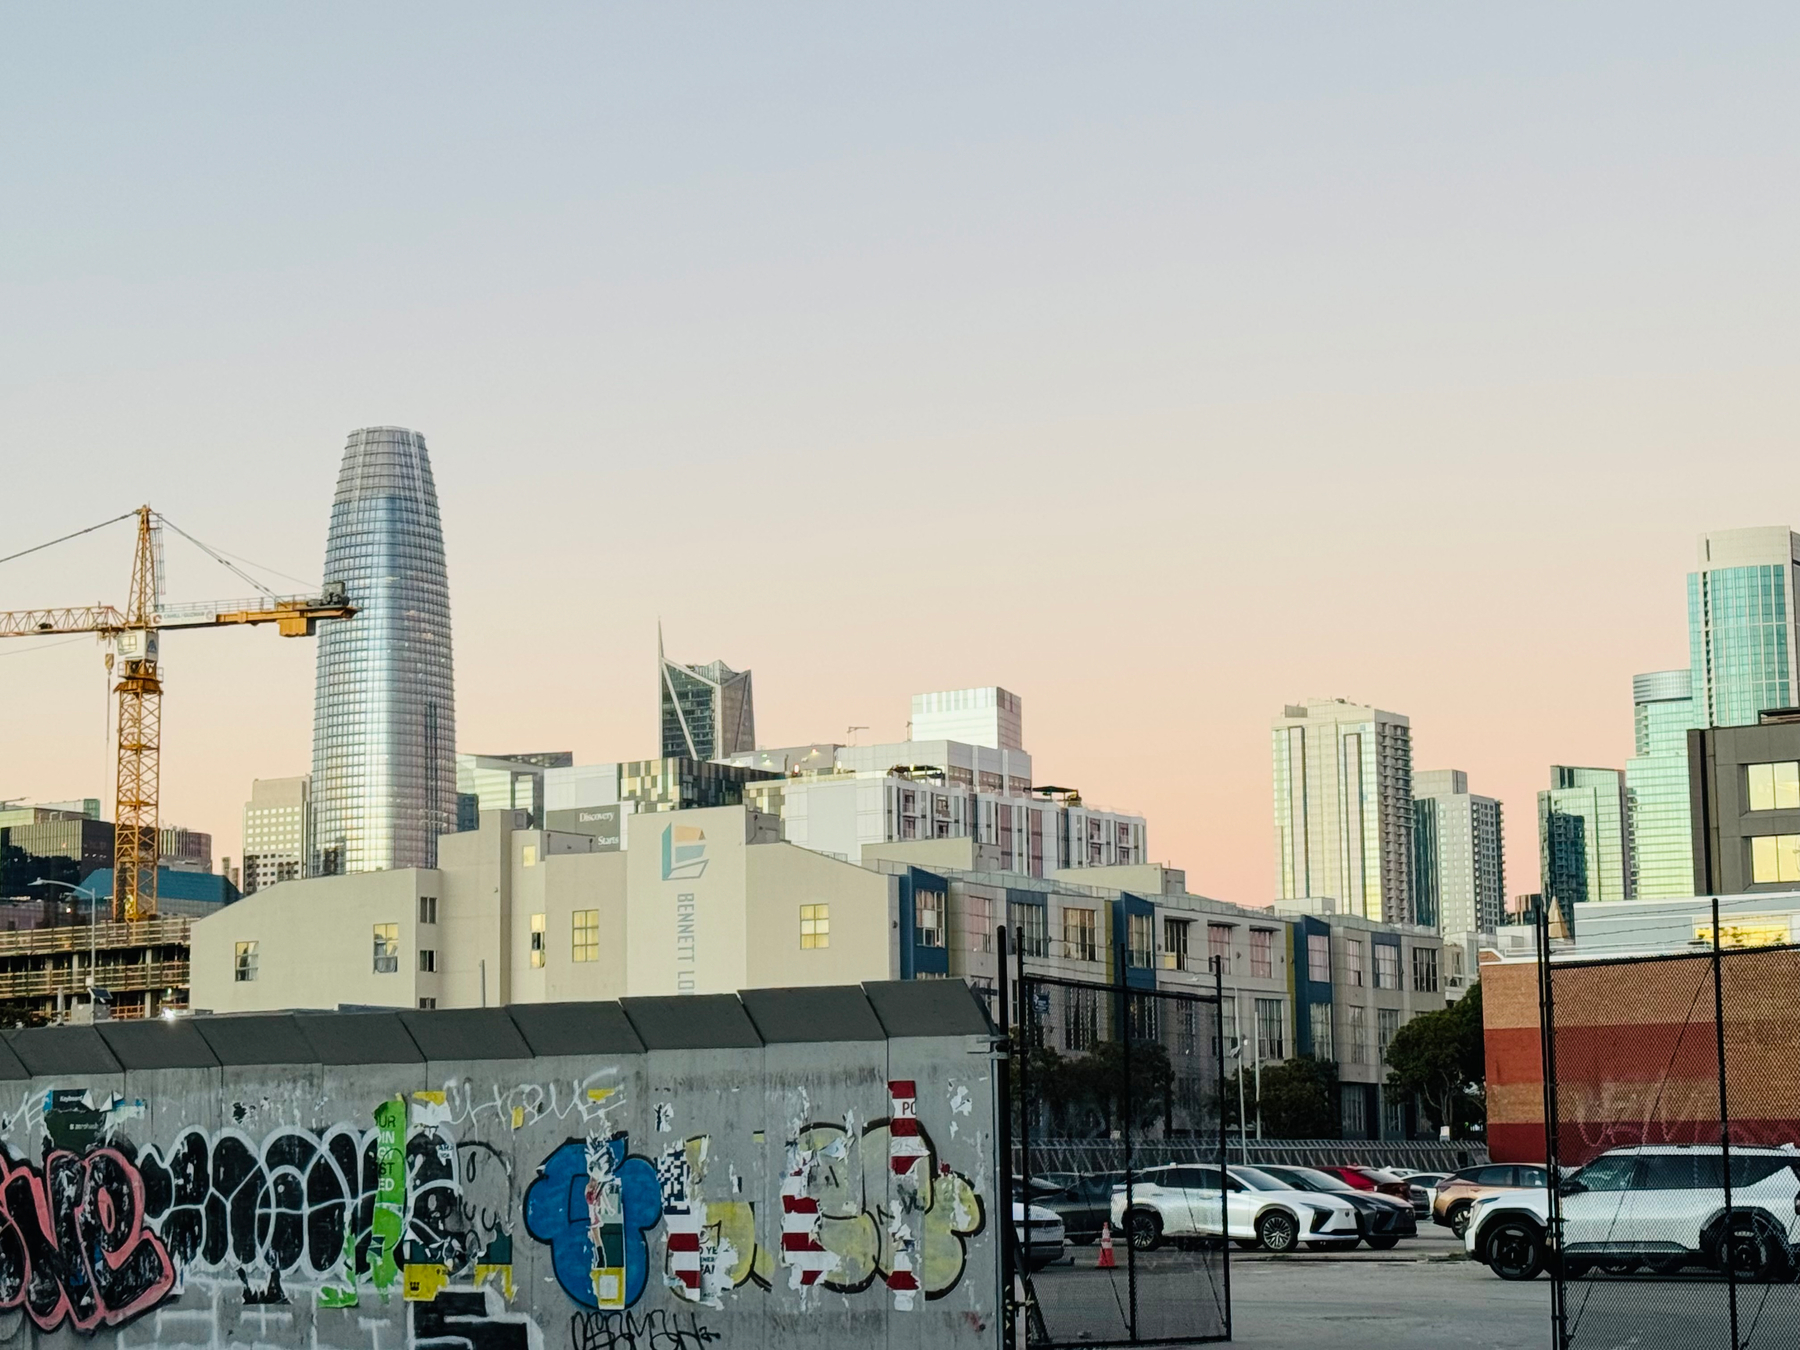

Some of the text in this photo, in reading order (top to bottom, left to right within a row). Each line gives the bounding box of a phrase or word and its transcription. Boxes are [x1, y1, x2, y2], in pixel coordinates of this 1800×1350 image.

[579, 812, 615, 822] Discovery
[597, 835, 619, 846] Starts
[677, 893, 695, 996] BENNETT LO
